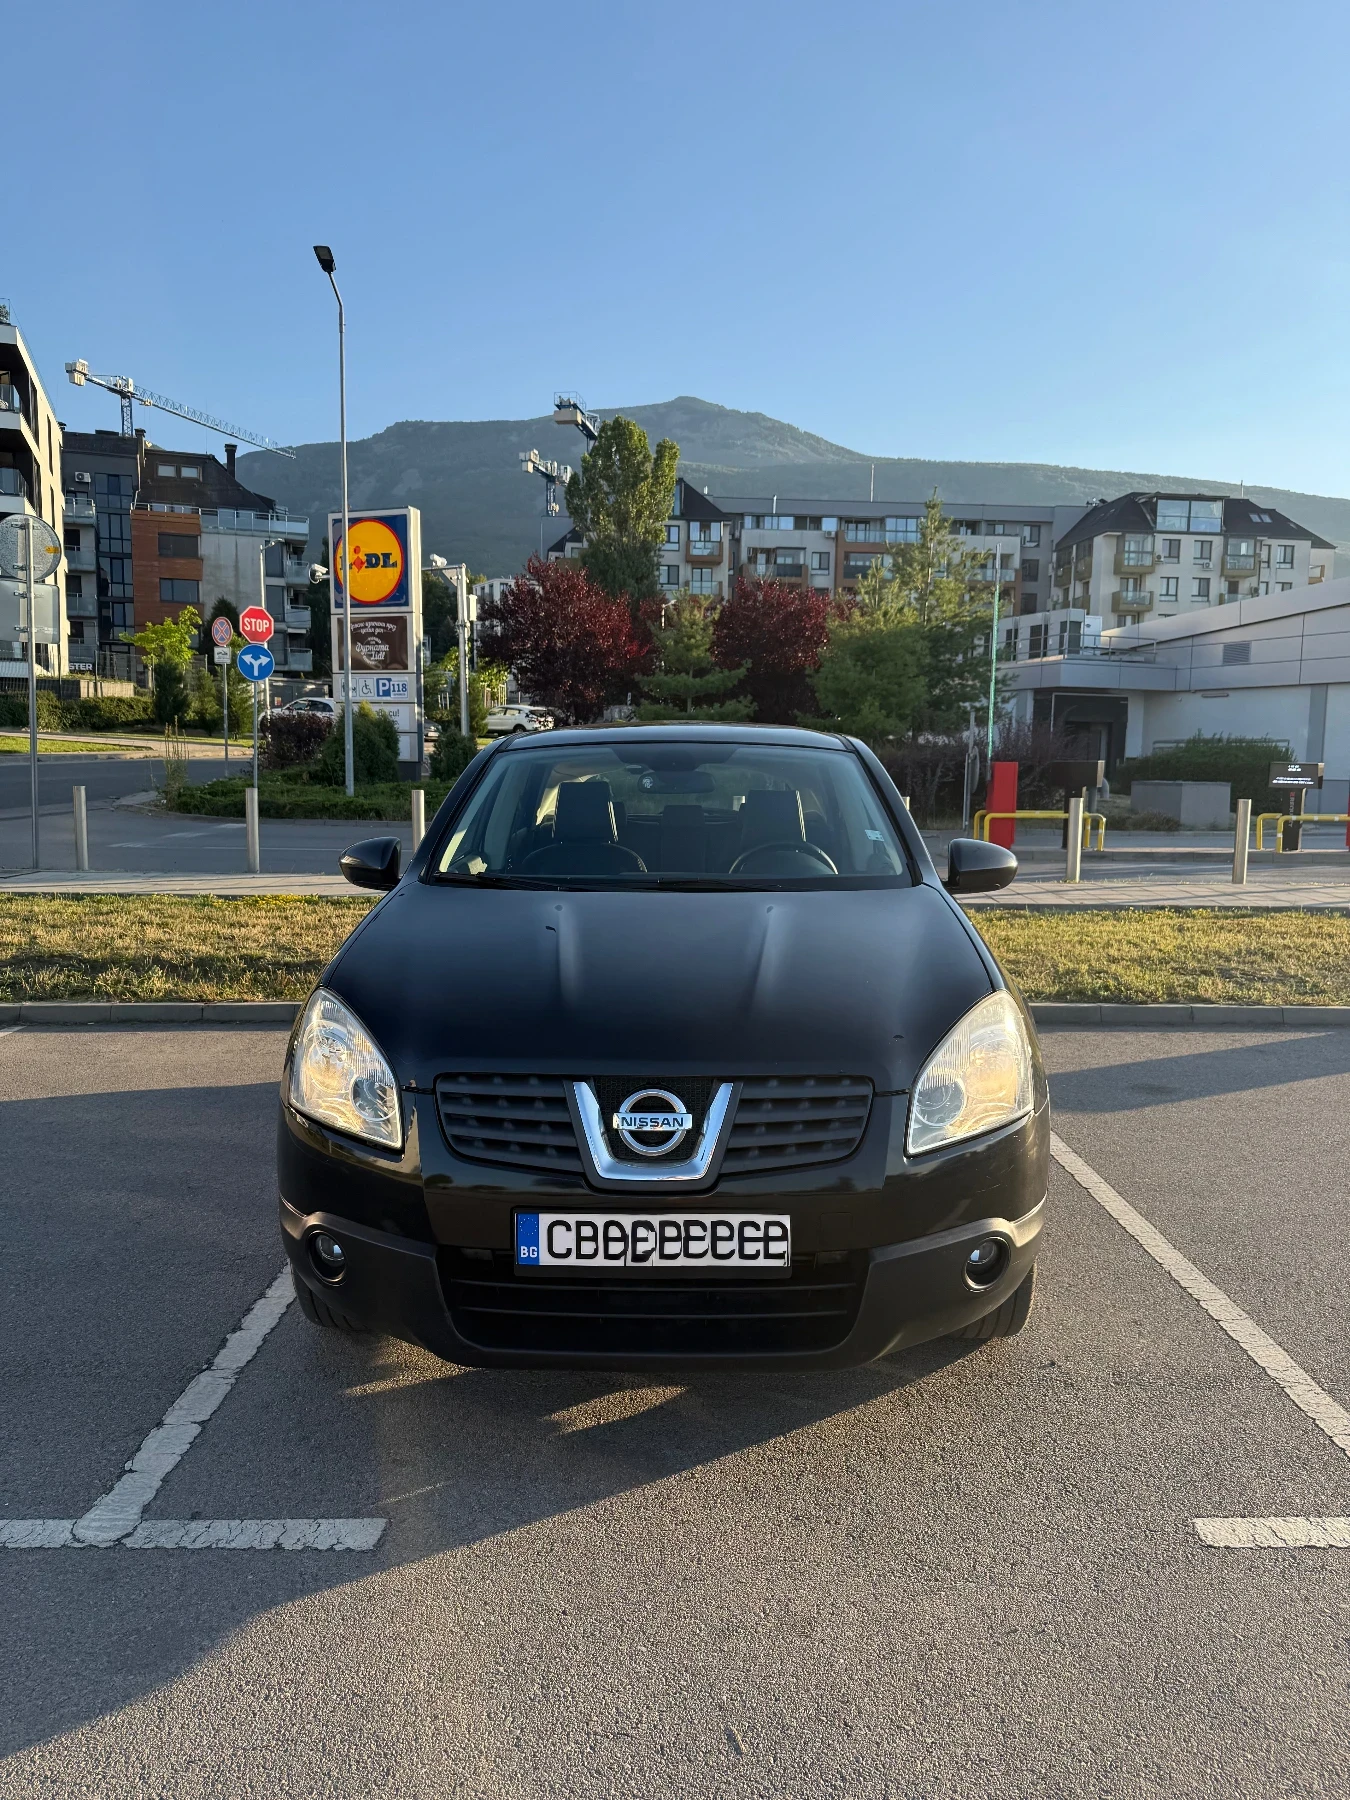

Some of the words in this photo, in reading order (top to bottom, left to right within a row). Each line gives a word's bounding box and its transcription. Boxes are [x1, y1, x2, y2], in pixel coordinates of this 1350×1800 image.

[244, 617, 270, 633] STOP
[355, 641, 390, 653] Фурната
[370, 651, 386, 661] Lidl
[378, 679, 390, 696] P
[391, 683, 407, 693] 118
[621, 1116, 684, 1128] NISSAN
[520, 1245, 538, 1258] BG
